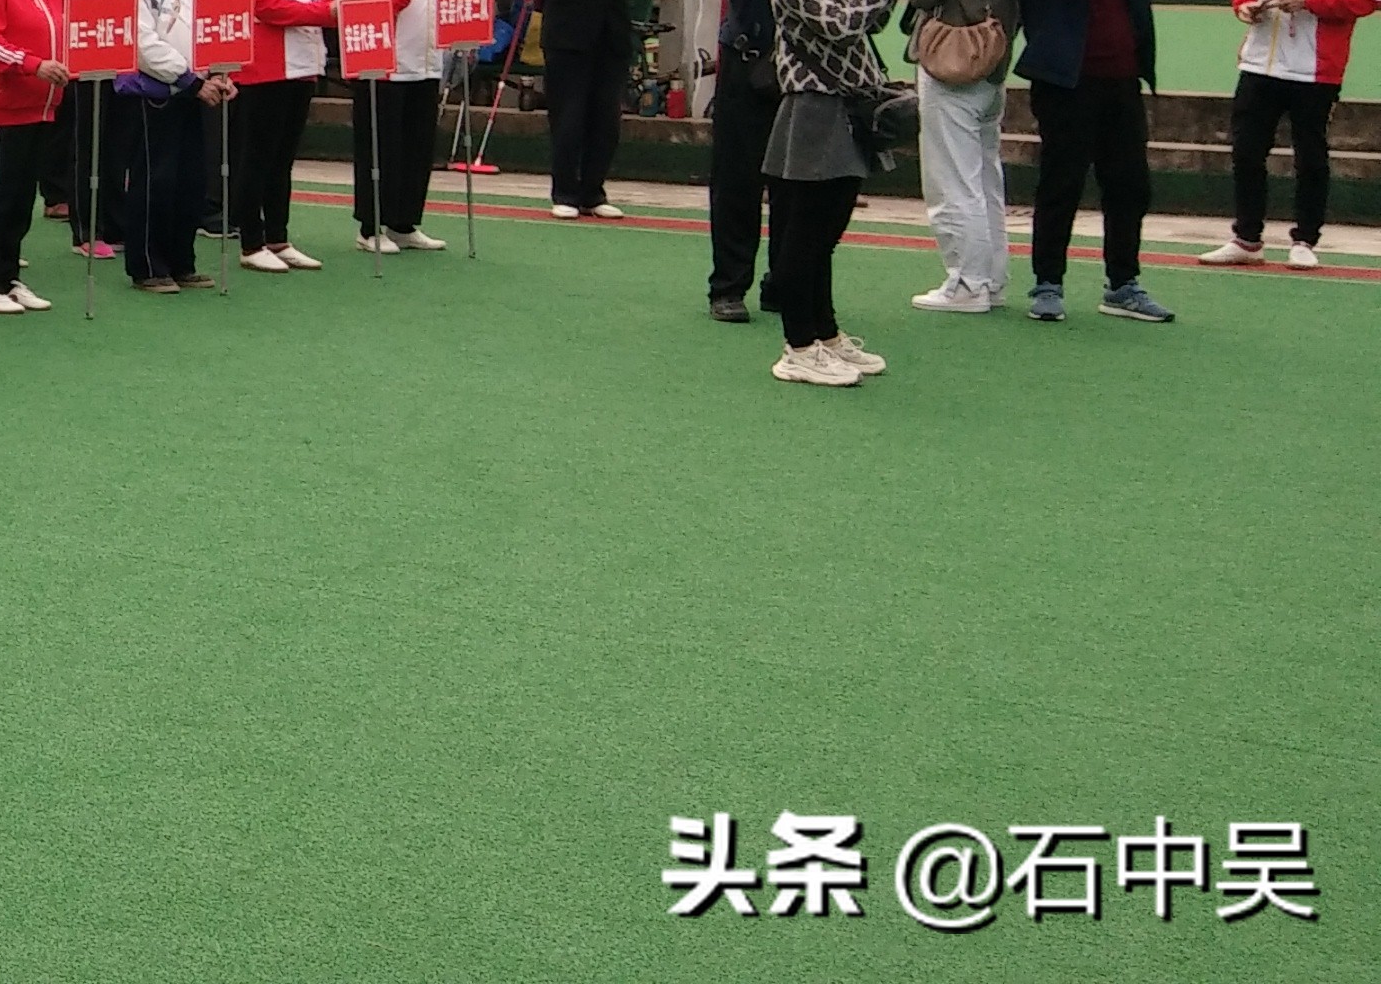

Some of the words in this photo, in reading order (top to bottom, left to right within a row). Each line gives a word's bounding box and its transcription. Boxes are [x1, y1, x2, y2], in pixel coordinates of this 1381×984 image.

[69, 16, 134, 49] 四三一社区一队
[196, 11, 251, 44] 四三一社区二队
[345, 21, 392, 54] 安岳代表一队
